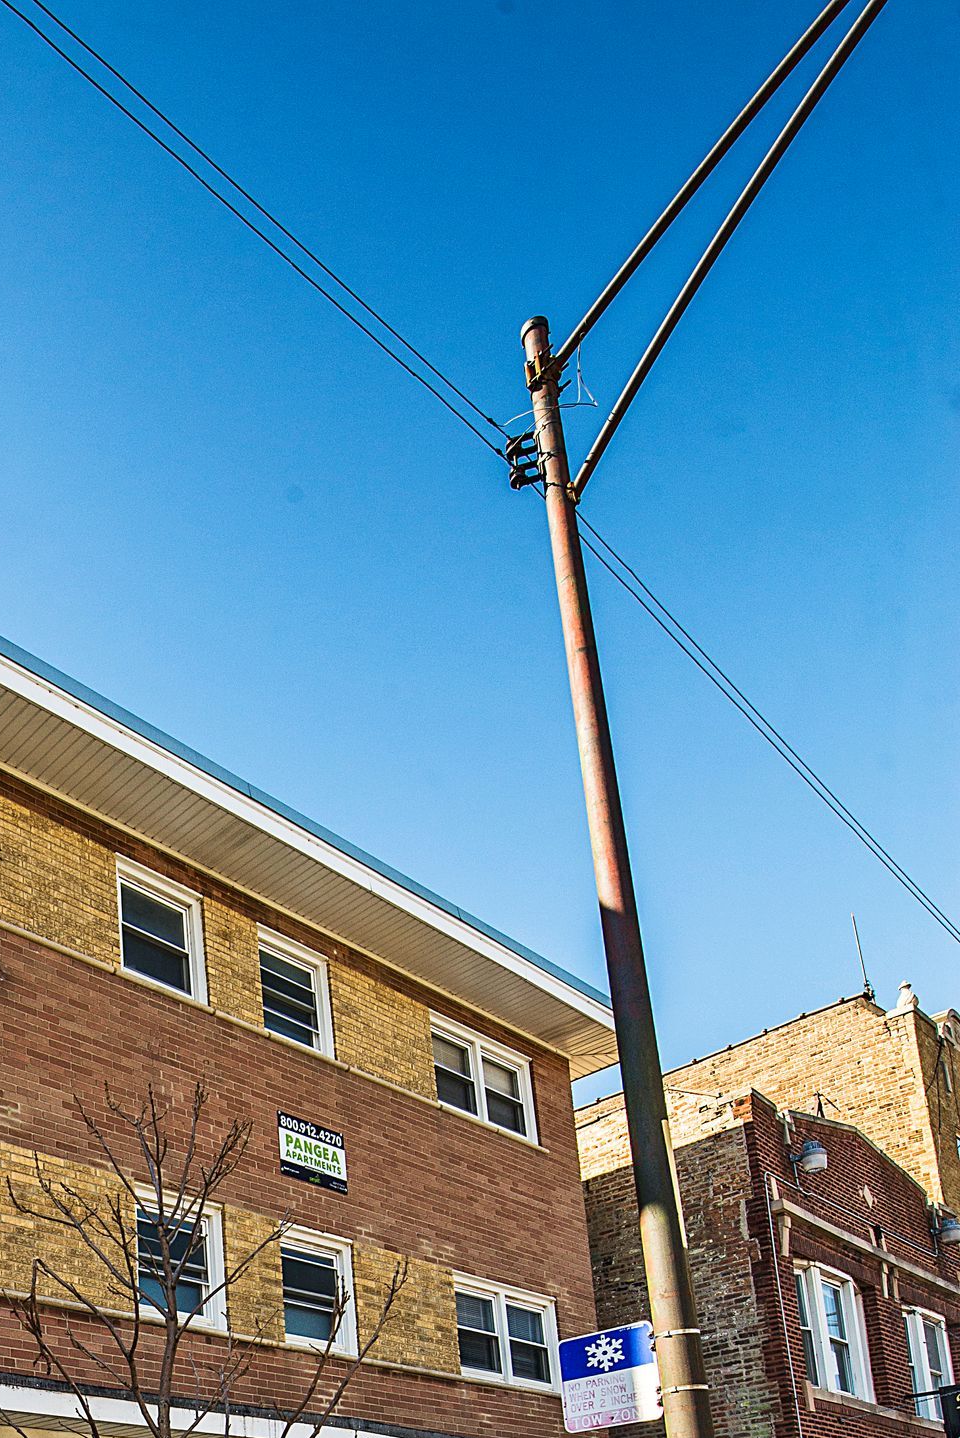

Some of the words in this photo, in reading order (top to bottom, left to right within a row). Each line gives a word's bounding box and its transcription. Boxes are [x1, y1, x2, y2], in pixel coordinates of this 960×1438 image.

[280, 1115, 342, 1147] 800.912.4270
[285, 1133, 340, 1165] PANGEA
[285, 1149, 342, 1175] APARTMENTS
[568, 1382, 581, 1393] NO
[585, 1373, 626, 1389] PARKING
[569, 1389, 596, 1403] WHEN
[600, 1383, 627, 1397] SNOW
[571, 1401, 595, 1413] OVER
[599, 1399, 607, 1408] 2
[611, 1392, 639, 1405] INCHE
[571, 1414, 603, 1430] TOW
[611, 1407, 641, 1423] ZON
